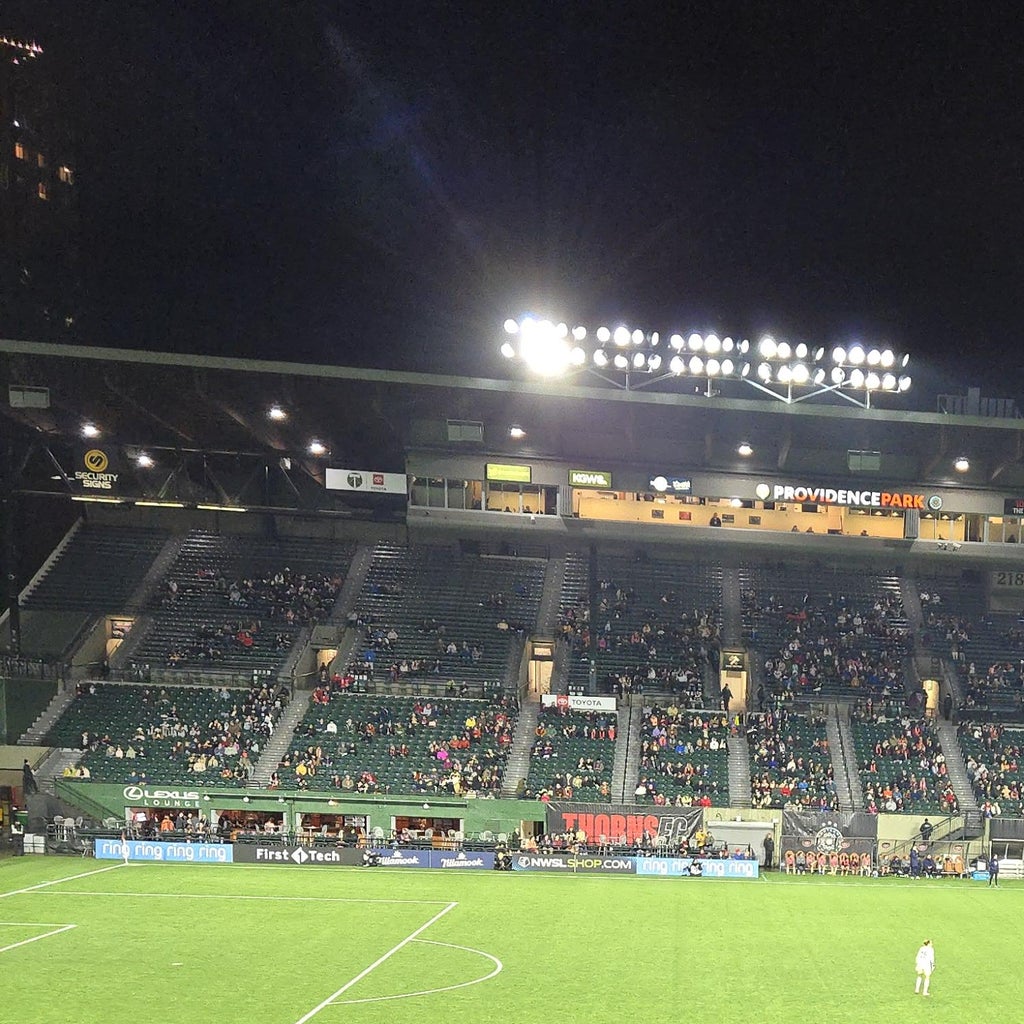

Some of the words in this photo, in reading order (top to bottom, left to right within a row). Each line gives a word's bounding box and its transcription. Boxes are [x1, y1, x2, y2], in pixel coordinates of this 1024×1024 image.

[75, 471, 118, 482] SECURITY
[83, 480, 112, 489] SIGNS
[997, 573, 1024, 586] 218
[572, 699, 602, 707] TOYOTA
[144, 790, 200, 800] LEXUS
[144, 799, 200, 808] LOUNGE
[562, 813, 659, 847] THORNS
[134, 843, 162, 860] ring
[166, 844, 195, 861] ring
[198, 845, 226, 863] ring
[256, 849, 289, 860] First
[308, 851, 340, 862] Tech
[642, 858, 668, 875] ring
[728, 861, 754, 878] ring
